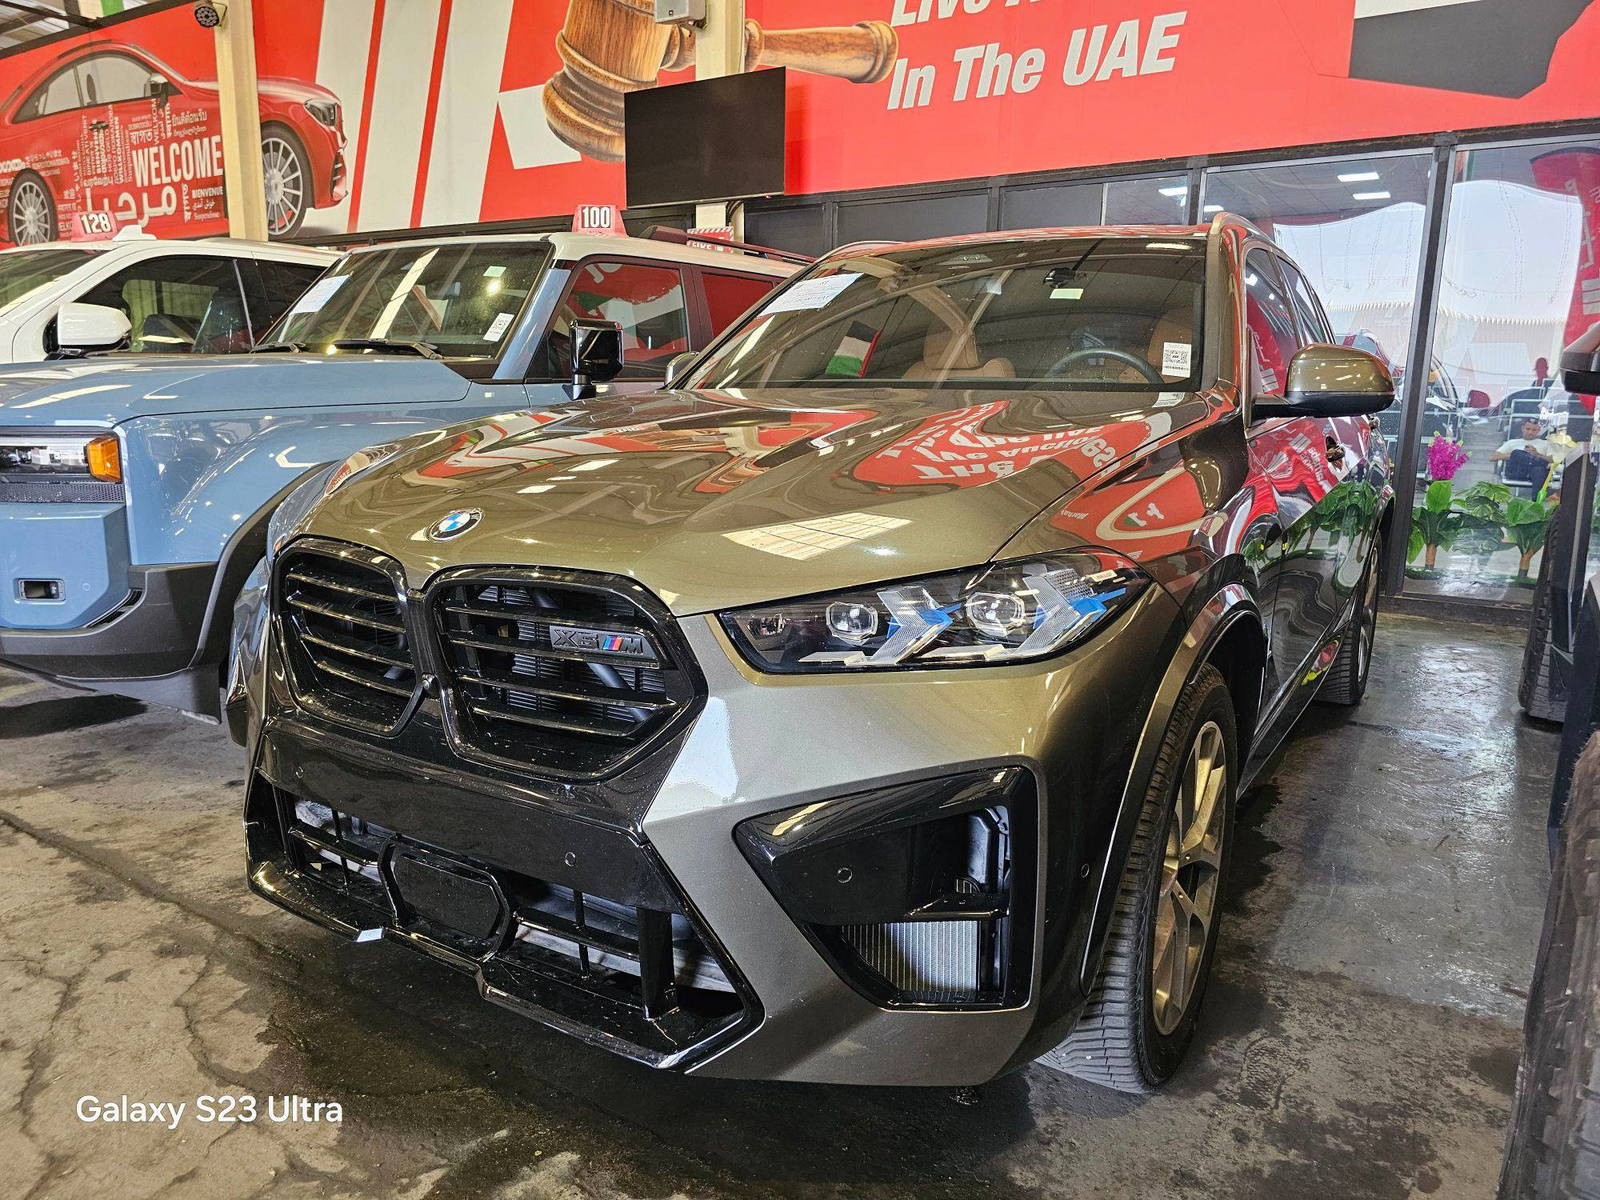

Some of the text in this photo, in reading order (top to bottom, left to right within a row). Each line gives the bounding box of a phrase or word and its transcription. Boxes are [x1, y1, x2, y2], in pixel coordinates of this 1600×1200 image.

[886, 11, 1188, 110] In The UAE
[131, 135, 224, 188] WELCOME
[80, 213, 112, 234] 128
[582, 206, 611, 228] 100
